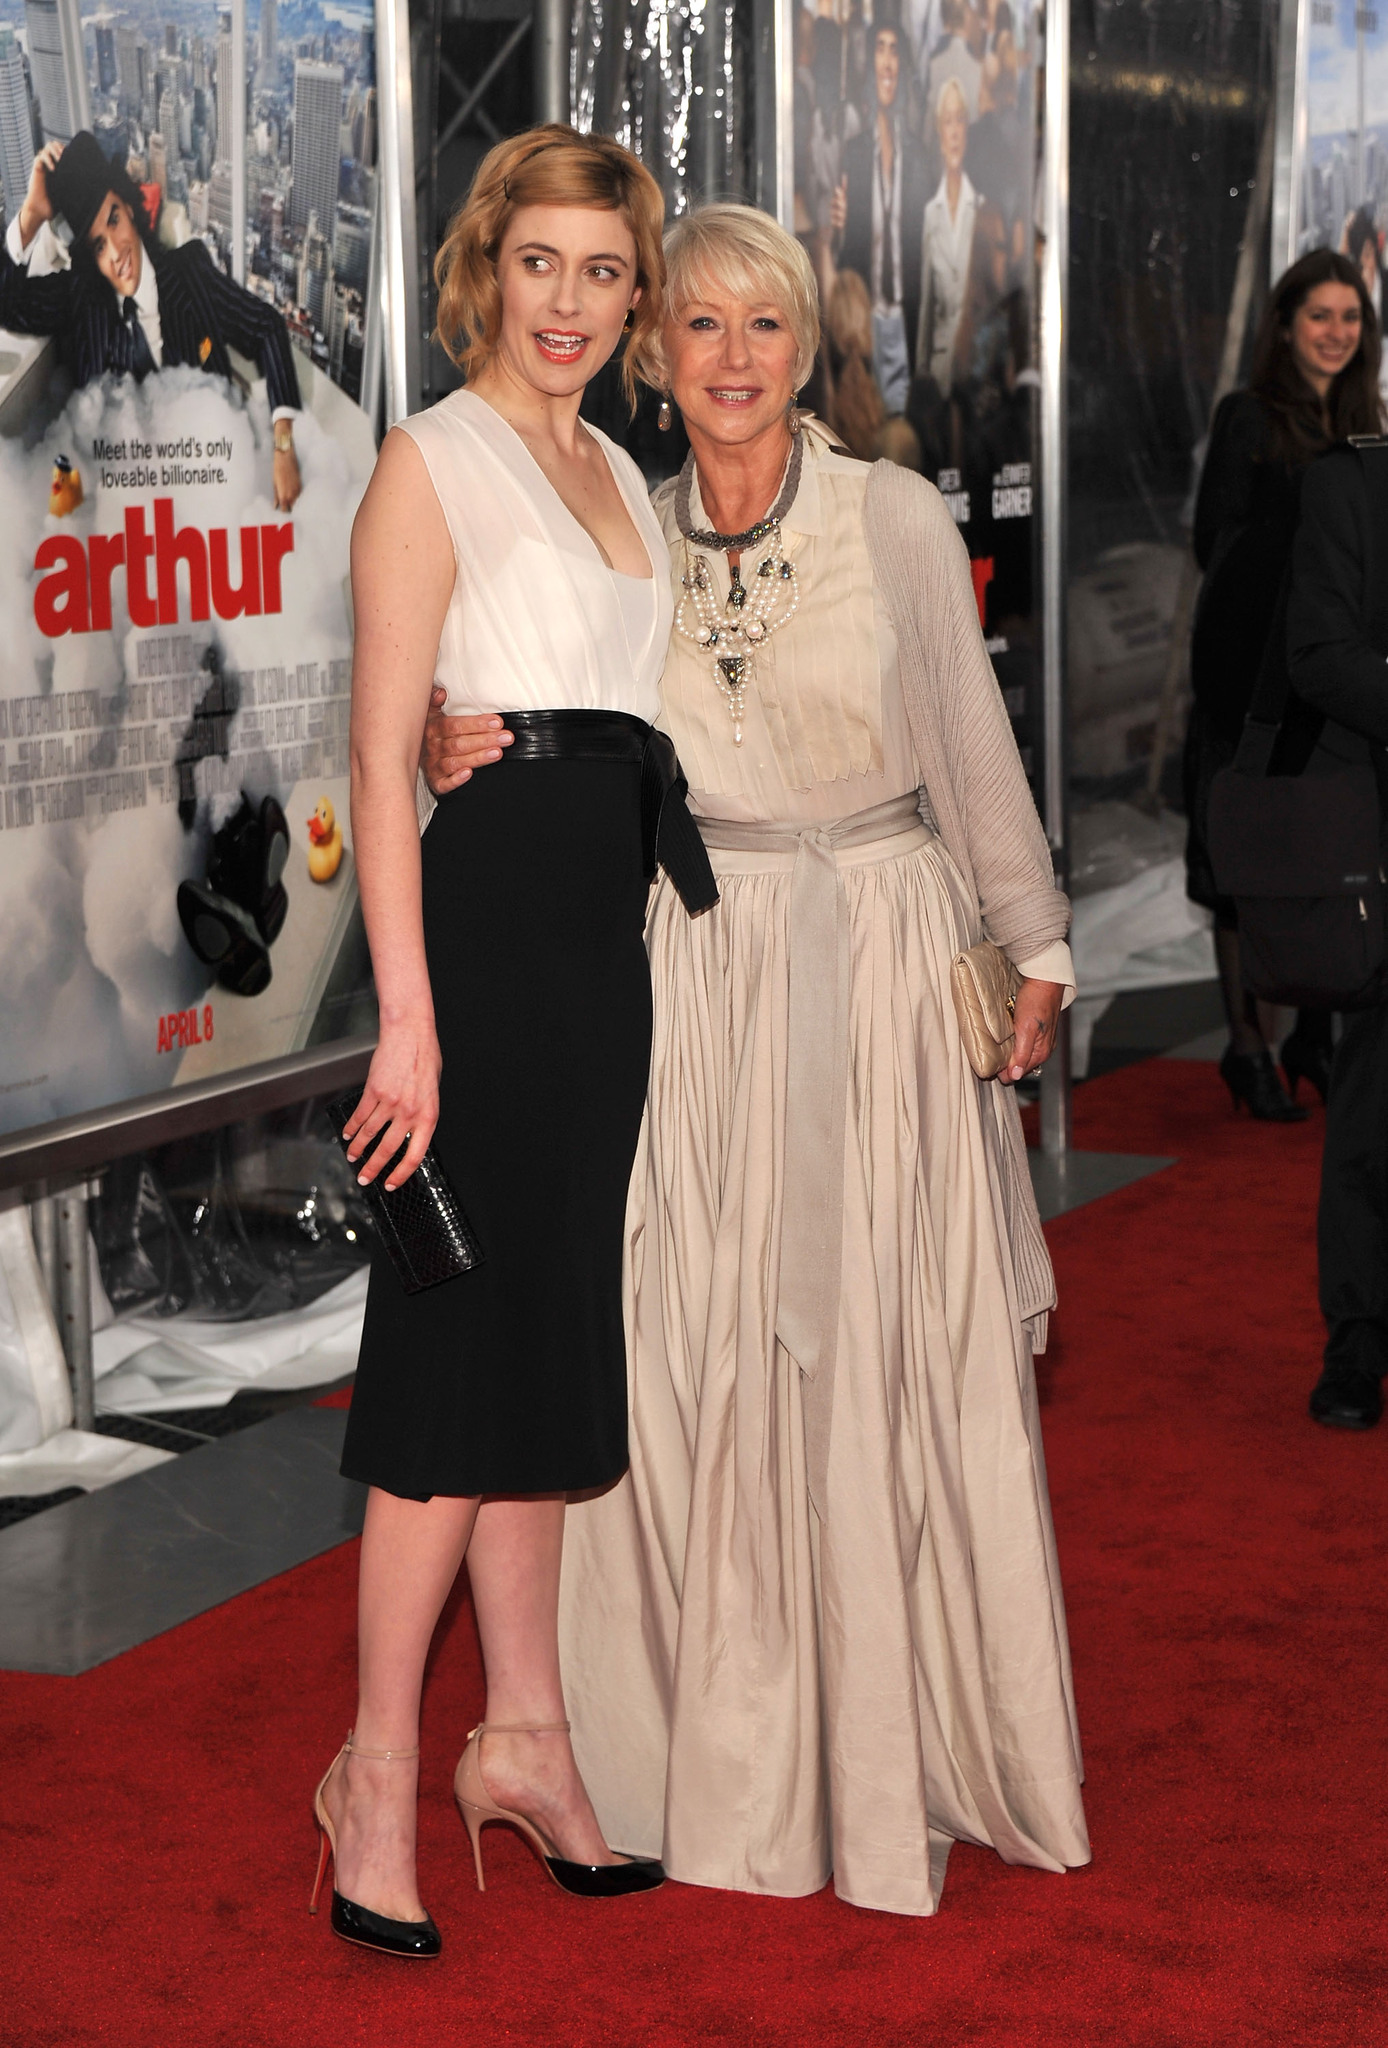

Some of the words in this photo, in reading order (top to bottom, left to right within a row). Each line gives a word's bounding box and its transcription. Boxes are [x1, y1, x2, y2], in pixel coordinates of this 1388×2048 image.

[93, 439, 127, 461] Meet
[131, 438, 152, 459] the
[156, 437, 203, 460] world's
[206, 437, 233, 461] only
[101, 465, 157, 488] loveable
[162, 464, 228, 486] billionaire.
[34, 498, 295, 637] arthur
[156, 1007, 203, 1053] APRIL
[203, 1003, 214, 1042] 8
